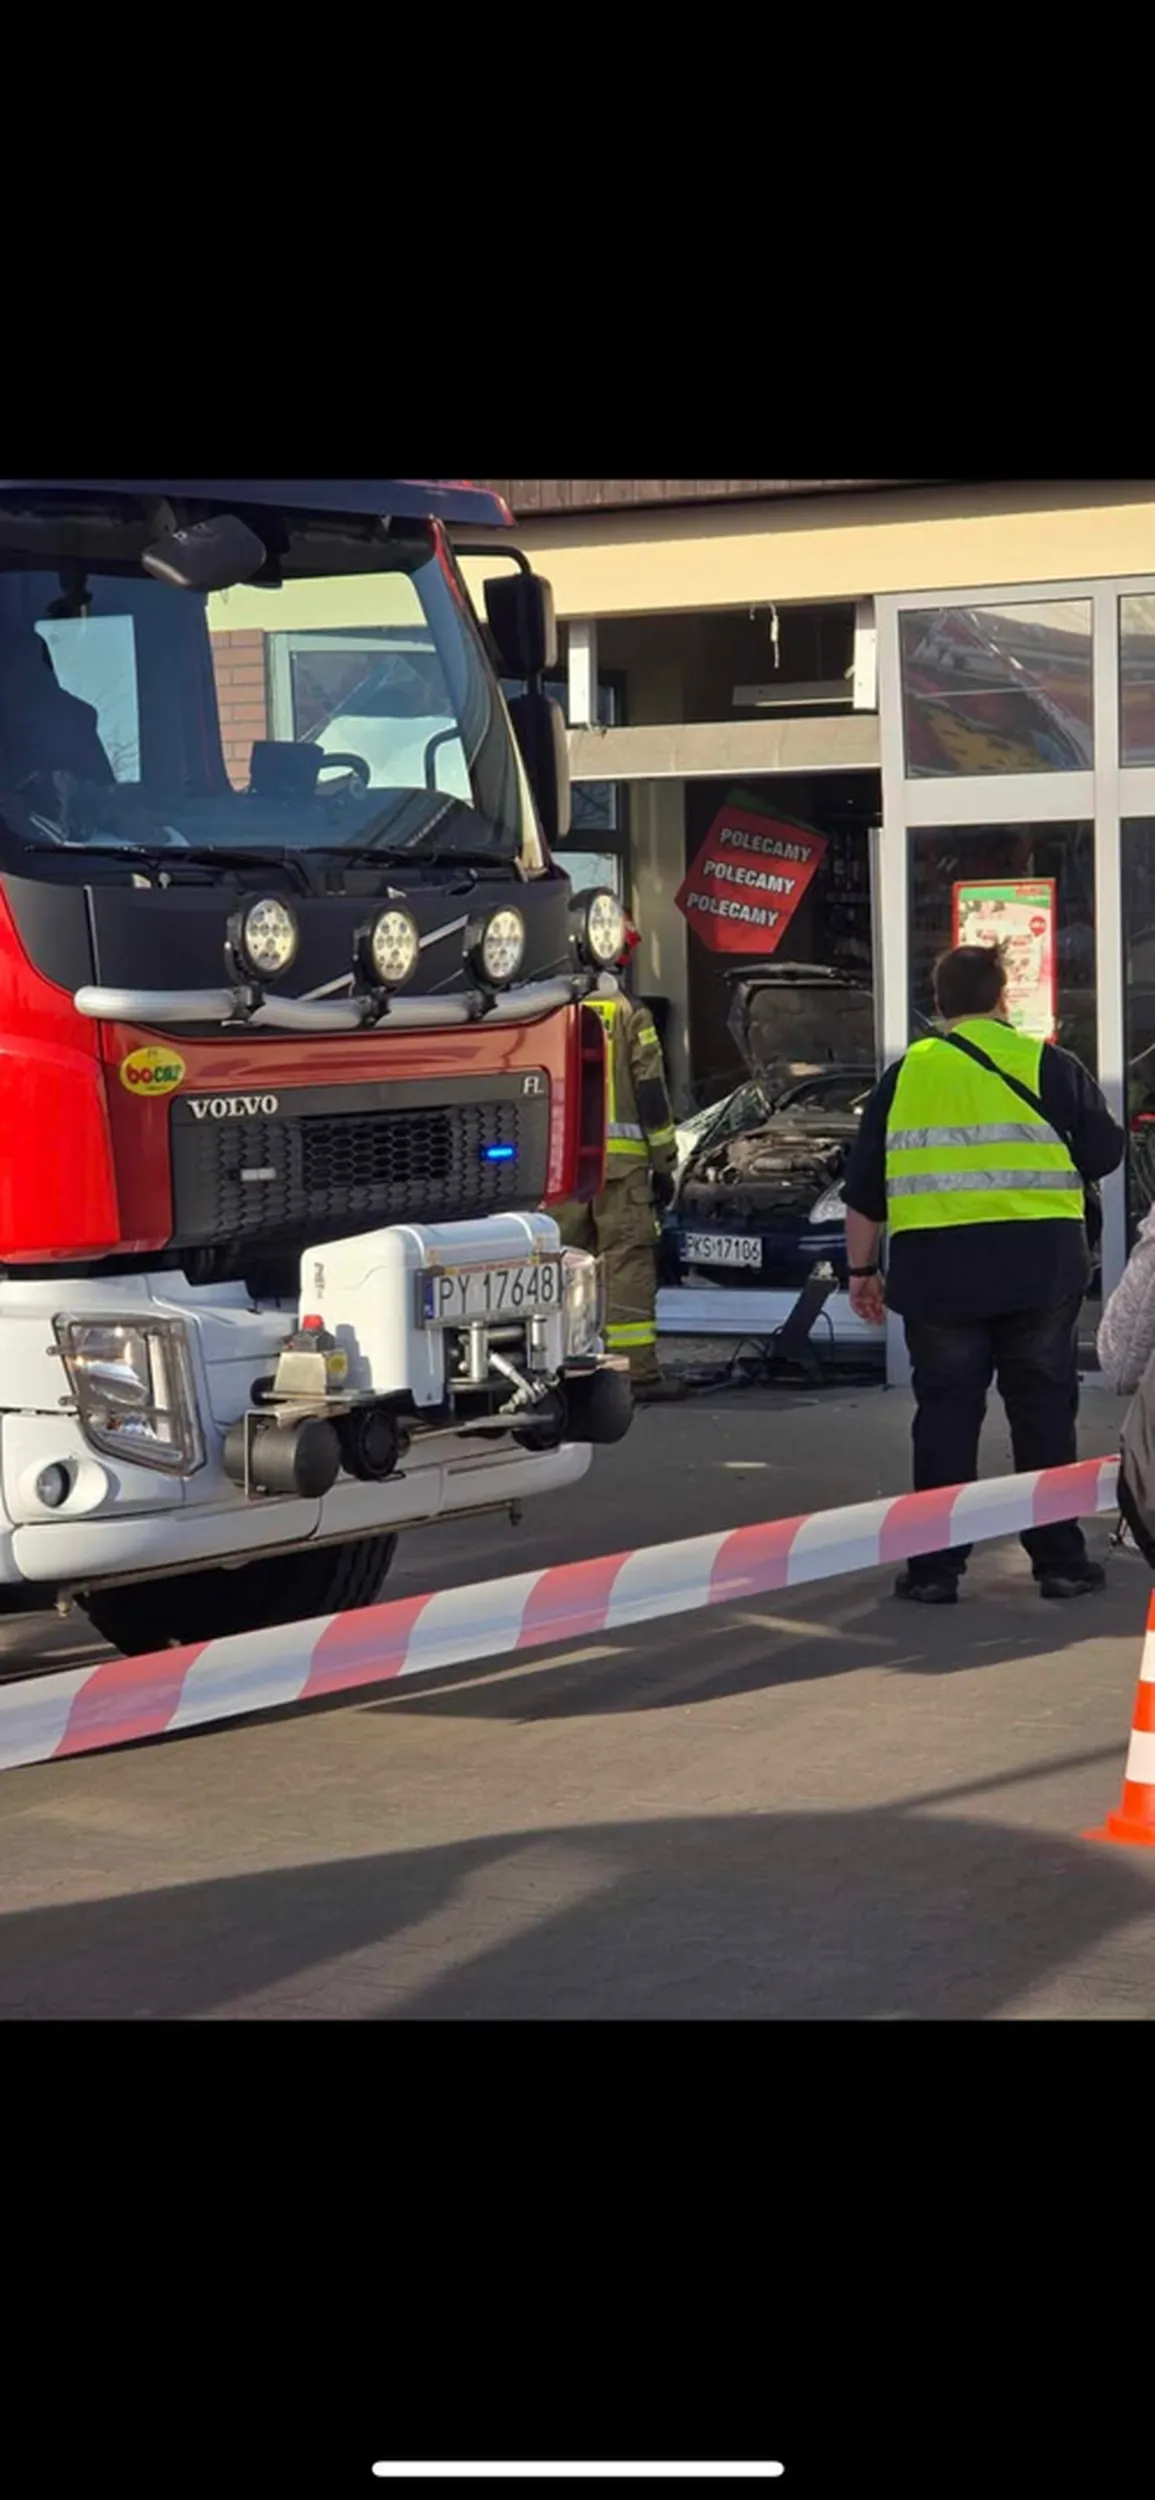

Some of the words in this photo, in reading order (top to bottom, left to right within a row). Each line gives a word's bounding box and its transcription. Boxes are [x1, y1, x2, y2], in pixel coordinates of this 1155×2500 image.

[719, 827, 812, 863] POLECAMY
[703, 859, 796, 895] POLECAMY
[686, 891, 780, 928] POLECAMY
[523, 1075, 546, 1094] FL
[187, 1093, 279, 1120] VOLVO
[439, 1274, 471, 1318] PY
[482, 1264, 554, 1313] 17648
